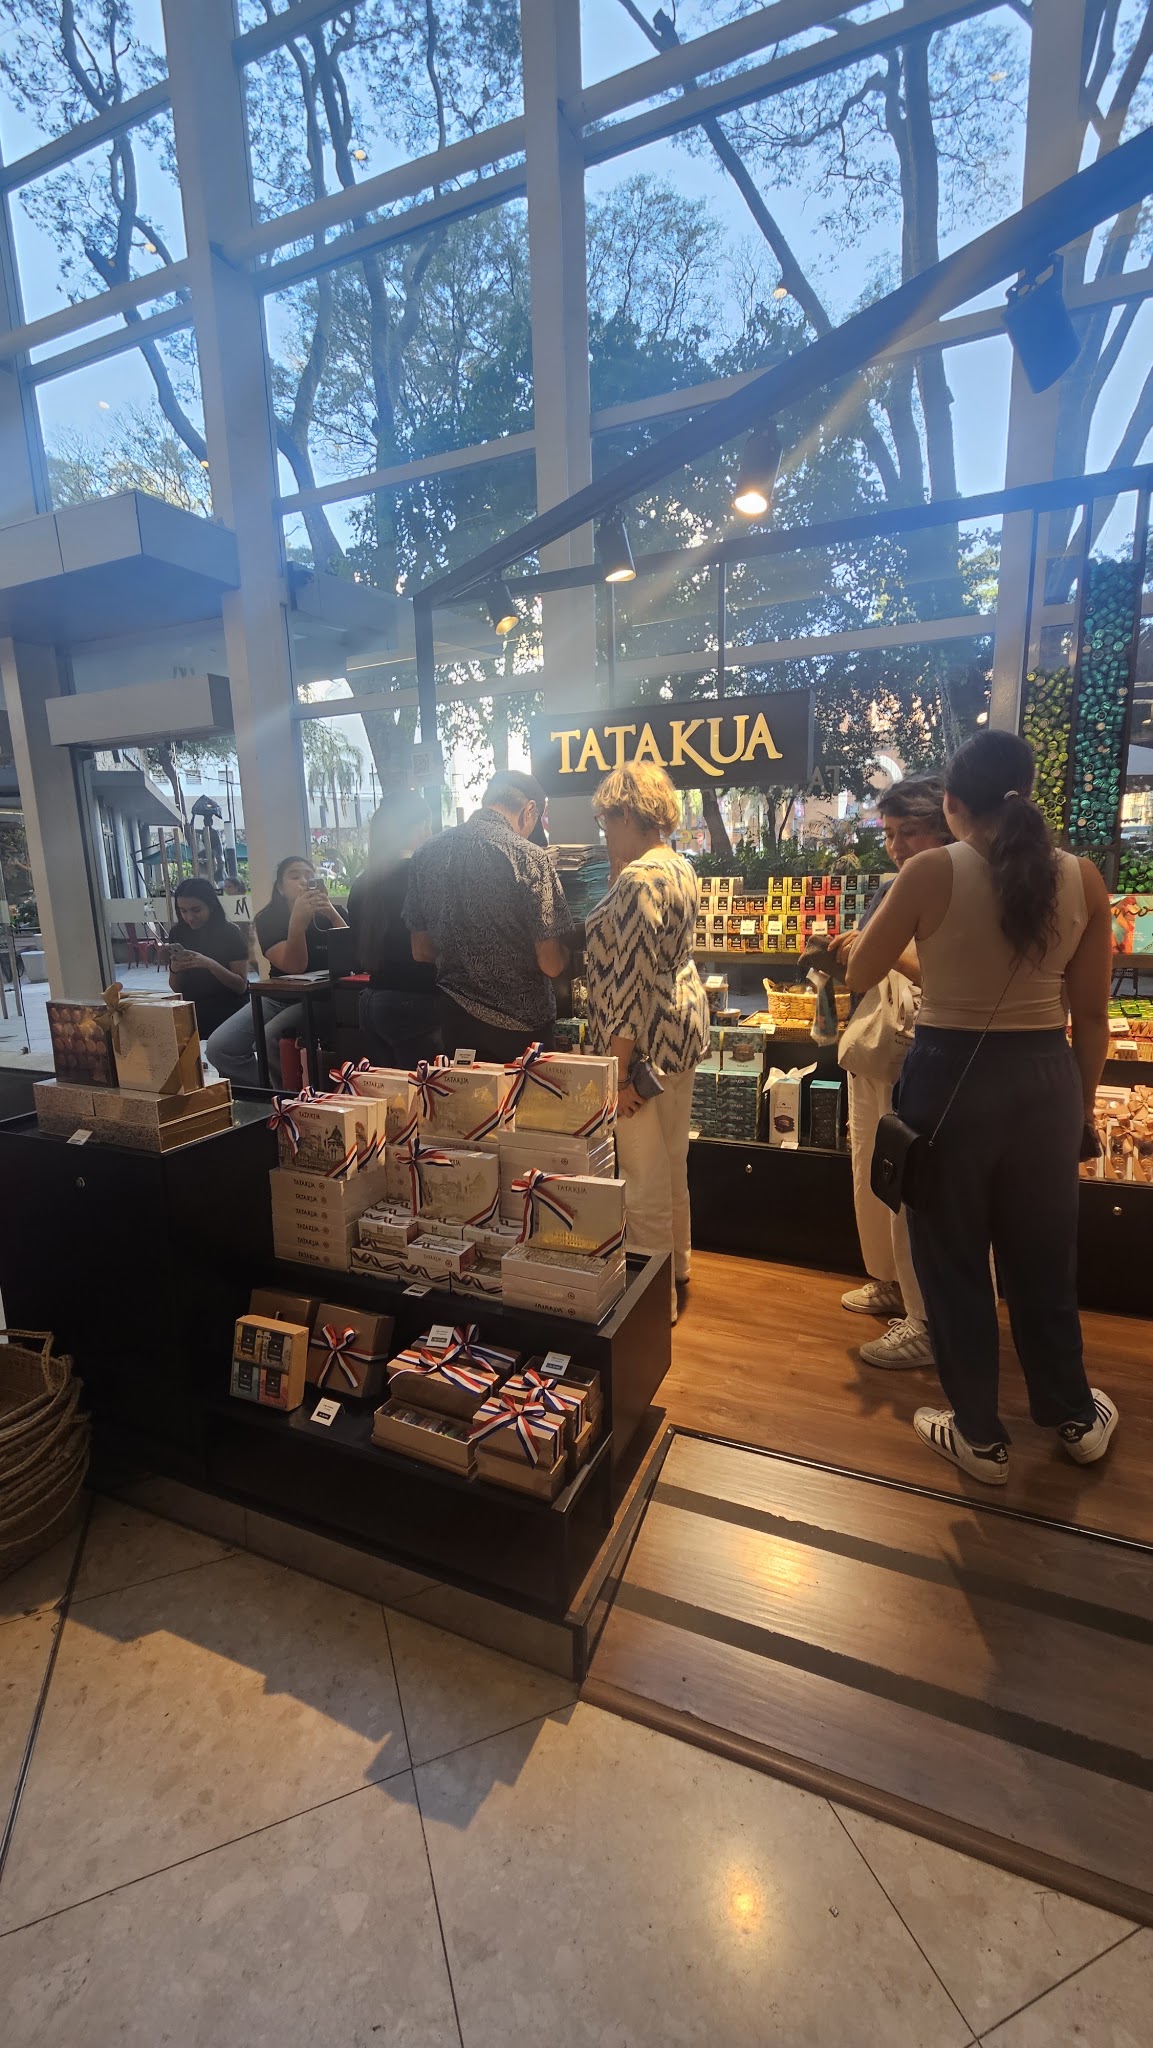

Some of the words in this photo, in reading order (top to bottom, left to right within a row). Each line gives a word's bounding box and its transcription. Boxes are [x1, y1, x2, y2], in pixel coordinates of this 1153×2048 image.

[550, 712, 783, 777] TATAKUA
[363, 1080, 385, 1089] TATAKUA
[444, 1076, 469, 1085] TATAKUA
[299, 1111, 320, 1120] TATAKUA
[293, 1179, 316, 1189] TATAKUA
[557, 1184, 587, 1195] TATAKUA
[295, 1193, 318, 1203] TATAKUA
[295, 1208, 318, 1218] TATAKUA
[297, 1223, 320, 1233] TATAKUA
[297, 1237, 319, 1247] TATAKUA
